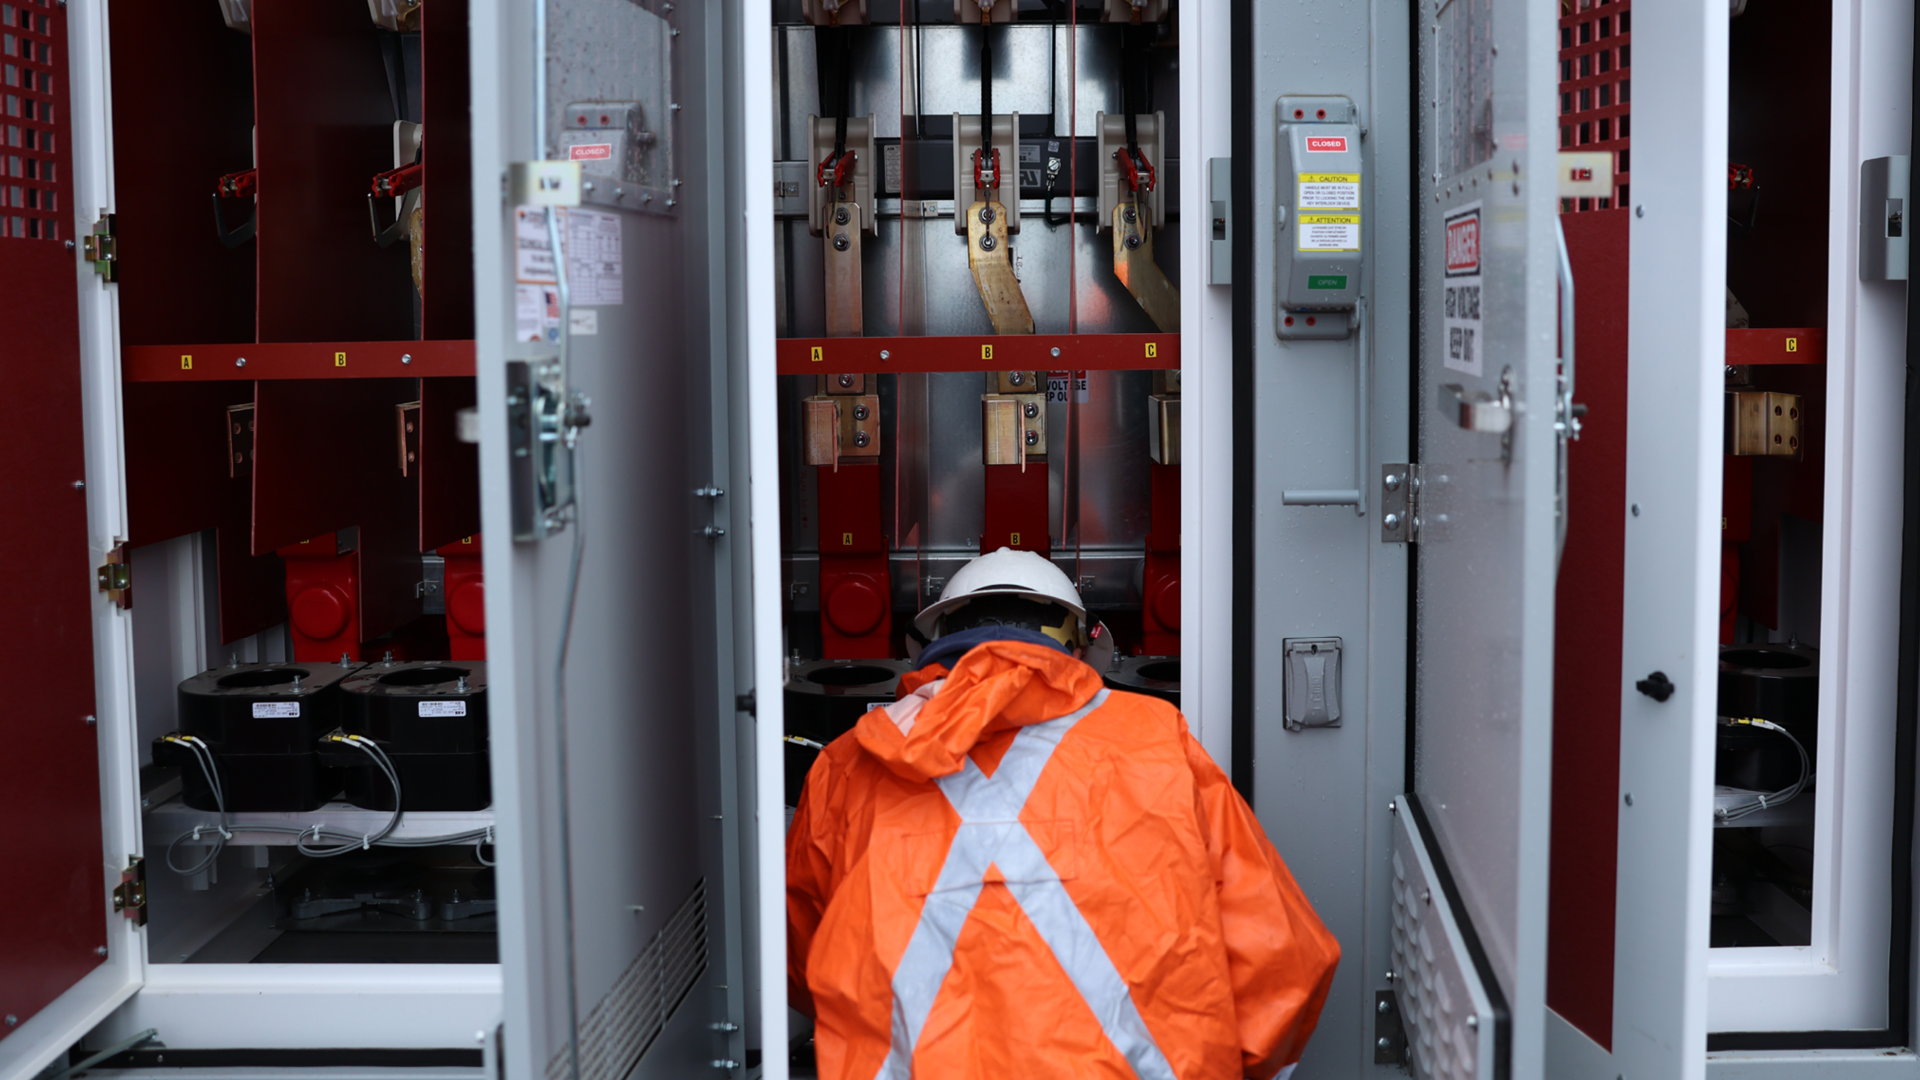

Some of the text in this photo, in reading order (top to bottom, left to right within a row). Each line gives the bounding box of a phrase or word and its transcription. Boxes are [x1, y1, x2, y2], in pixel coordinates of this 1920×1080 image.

[575, 148, 606, 156] CLOSED
[1448, 223, 1477, 266] DANGER
[1148, 344, 1154, 356] C
[1789, 339, 1795, 350] C
[814, 349, 820, 360] A
[985, 346, 991, 358] B
[183, 357, 189, 368] A
[338, 354, 344, 365] B
[846, 534, 850, 544] A
[1013, 534, 1018, 544] B
